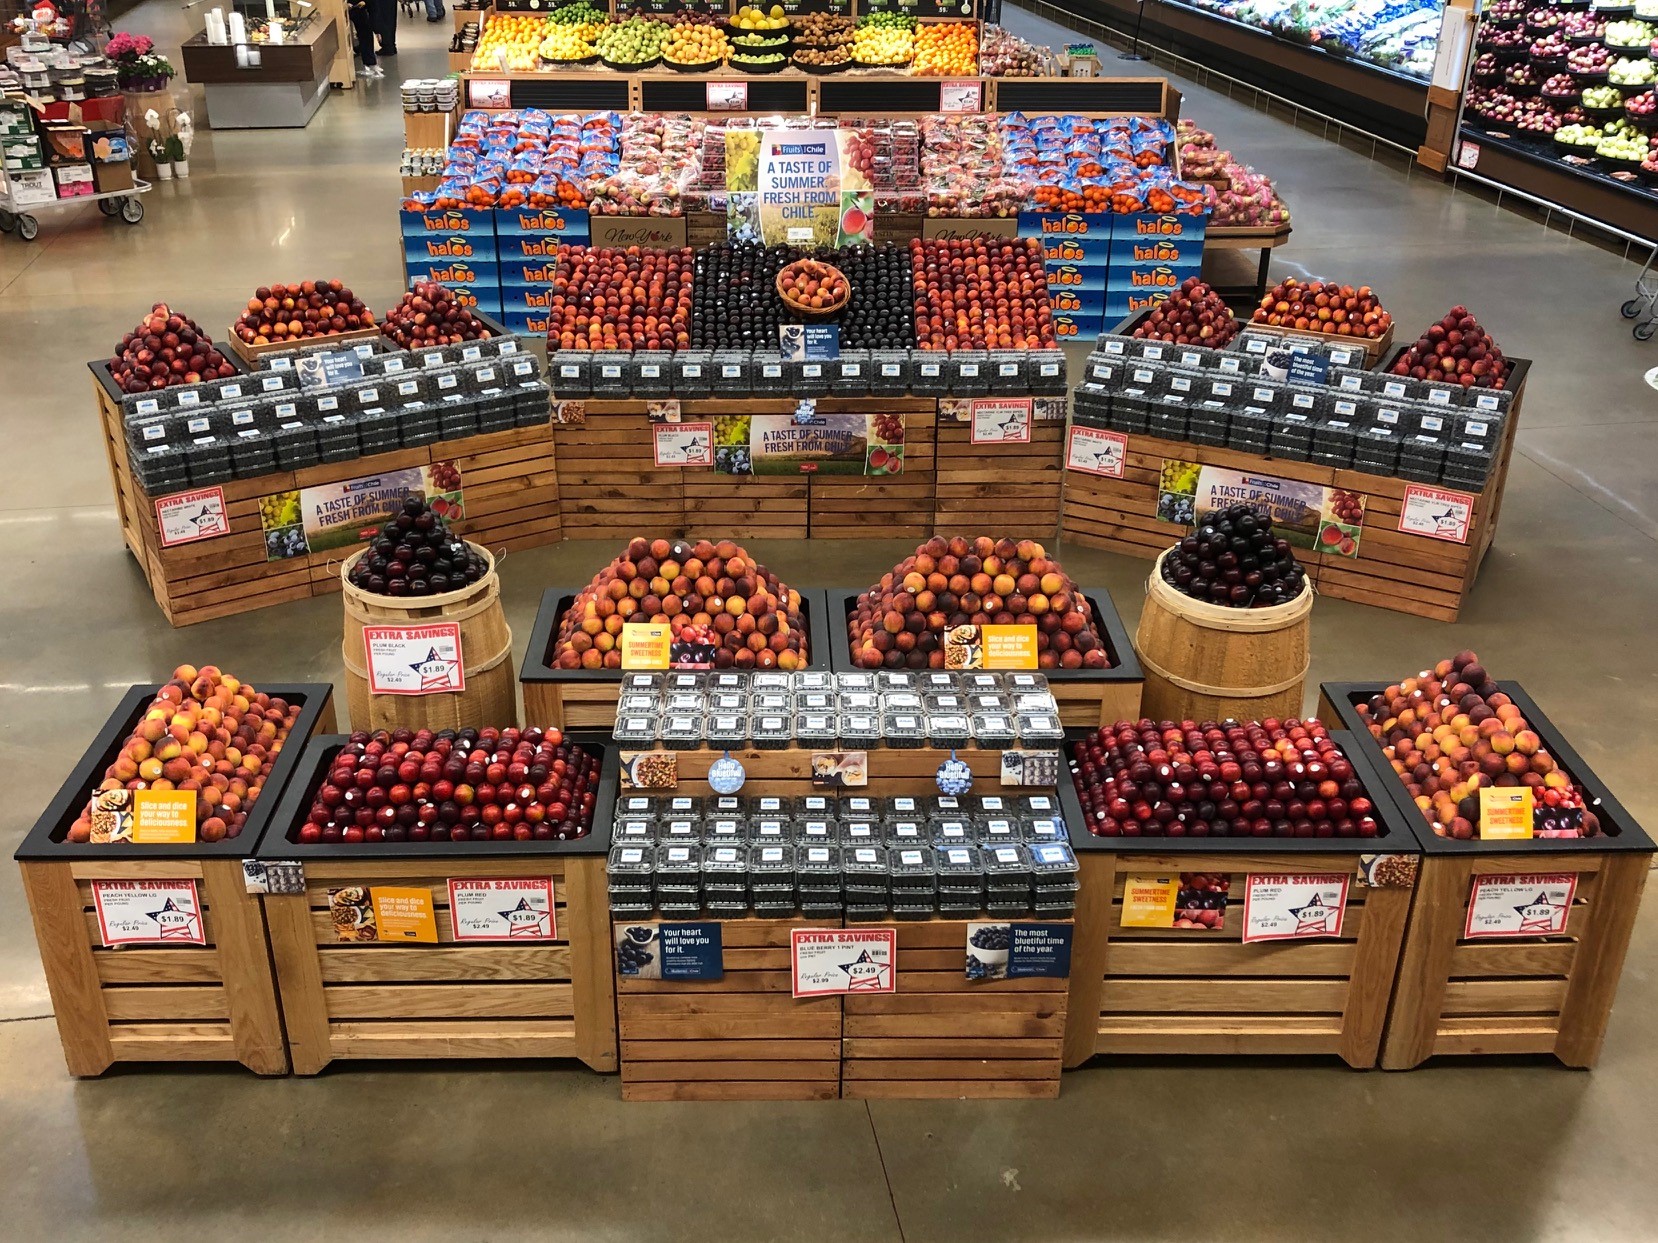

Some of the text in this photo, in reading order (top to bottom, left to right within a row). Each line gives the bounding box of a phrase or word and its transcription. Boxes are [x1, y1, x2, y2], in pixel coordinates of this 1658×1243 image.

[782, 144, 800, 154] Fruits
[768, 161, 832, 174] A TASTE OF
[771, 177, 828, 189] SUMMER.
[764, 192, 836, 204] FRESH FROM
[423, 214, 470, 230] halos
[519, 214, 565, 230] halos
[1042, 218, 1088, 233] halos
[1137, 218, 1182, 235] halos
[427, 240, 473, 256] halos
[1134, 245, 1179, 260] halos
[430, 266, 475, 282] halos
[1132, 270, 1177, 286] halos
[763, 432, 769, 441] A
[770, 430, 796, 441] TASTE
[800, 430, 810, 439] OF
[1072, 430, 1093, 438] EXTRA
[1096, 434, 1124, 443] SAVINGS
[765, 441, 822, 453] FRESH FROM
[1211, 485, 1216, 495] A
[1219, 486, 1246, 498] TASTE
[1250, 490, 1262, 500] OF
[1410, 490, 1433, 499] EXTRA
[1435, 494, 1469, 505] SAVINGS
[160, 492, 219, 508] EXTRA SAVINGS
[317, 504, 323, 515] A
[323, 497, 351, 512] TASTE
[354, 493, 366, 505] OF
[319, 503, 379, 526] FRESH FROM
[370, 629, 454, 640] EXTRA SAVINGS
[423, 665, 444, 673] $1.89
[141, 802, 187, 810] Slice and dice
[99, 882, 190, 890] EXTRA SAVINGS
[455, 881, 547, 890] EXTRA SAVINGS
[1253, 875, 1343, 885] EXTRA SAVINGS
[1480, 876, 1570, 885] EXTRA SAVINGS
[798, 934, 890, 943] EXTRA SAVINGS
